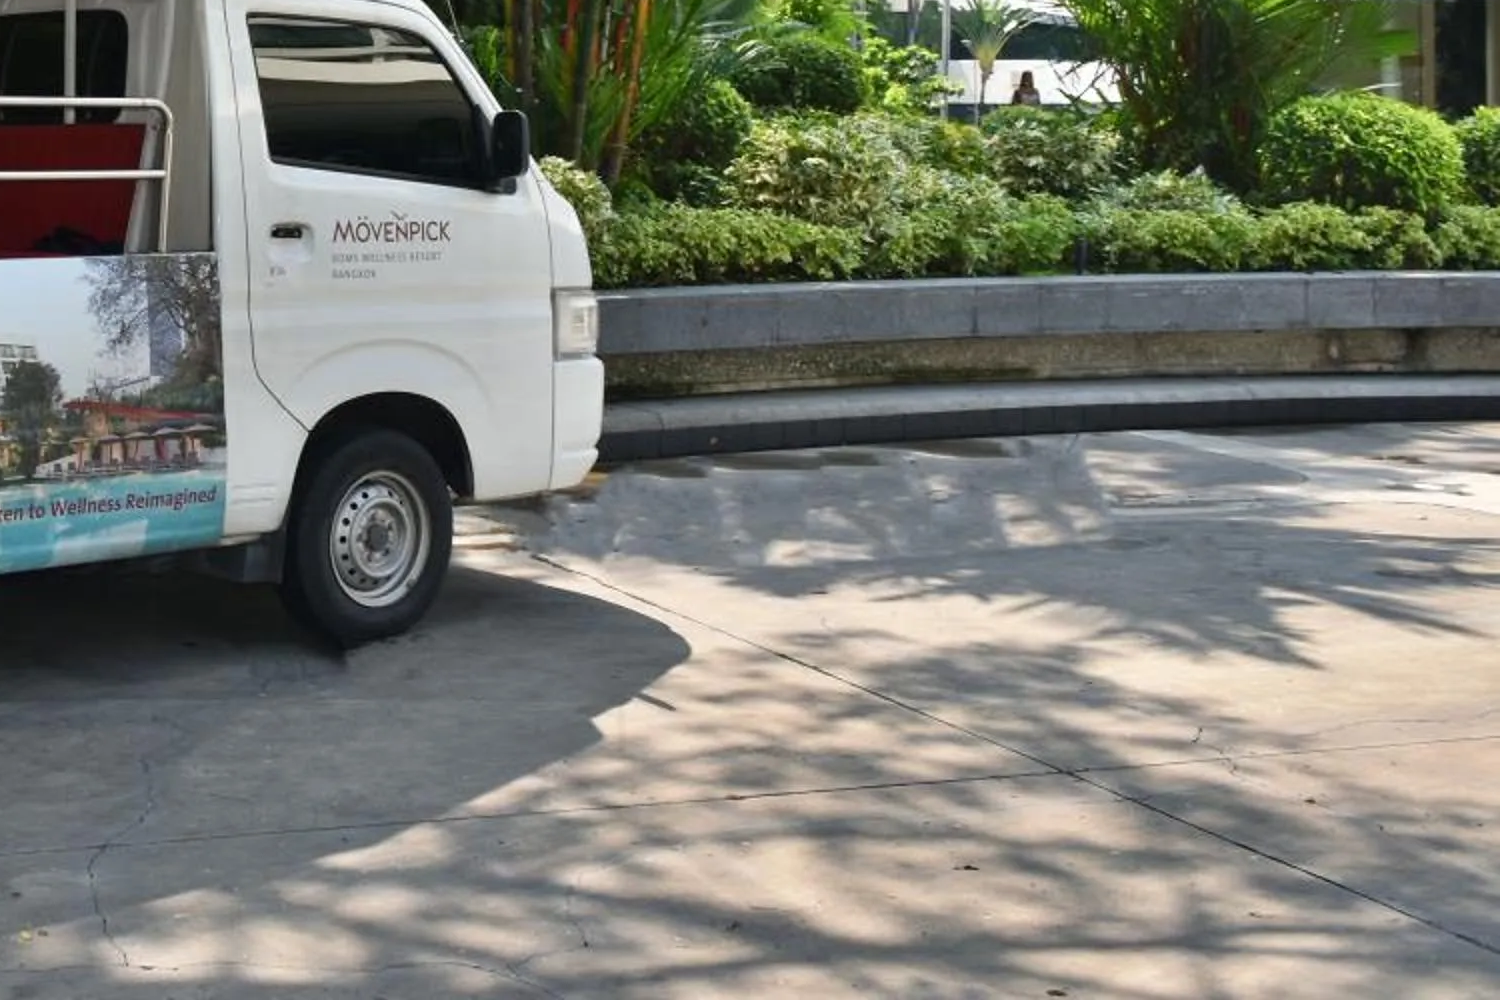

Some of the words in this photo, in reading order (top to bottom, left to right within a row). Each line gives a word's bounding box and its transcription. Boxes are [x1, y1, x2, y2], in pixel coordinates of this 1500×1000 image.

[333, 215, 451, 243] MÖVENPICK
[27, 504, 45, 519] to
[50, 496, 122, 517] Wellness
[125, 485, 218, 511] Reimagined
